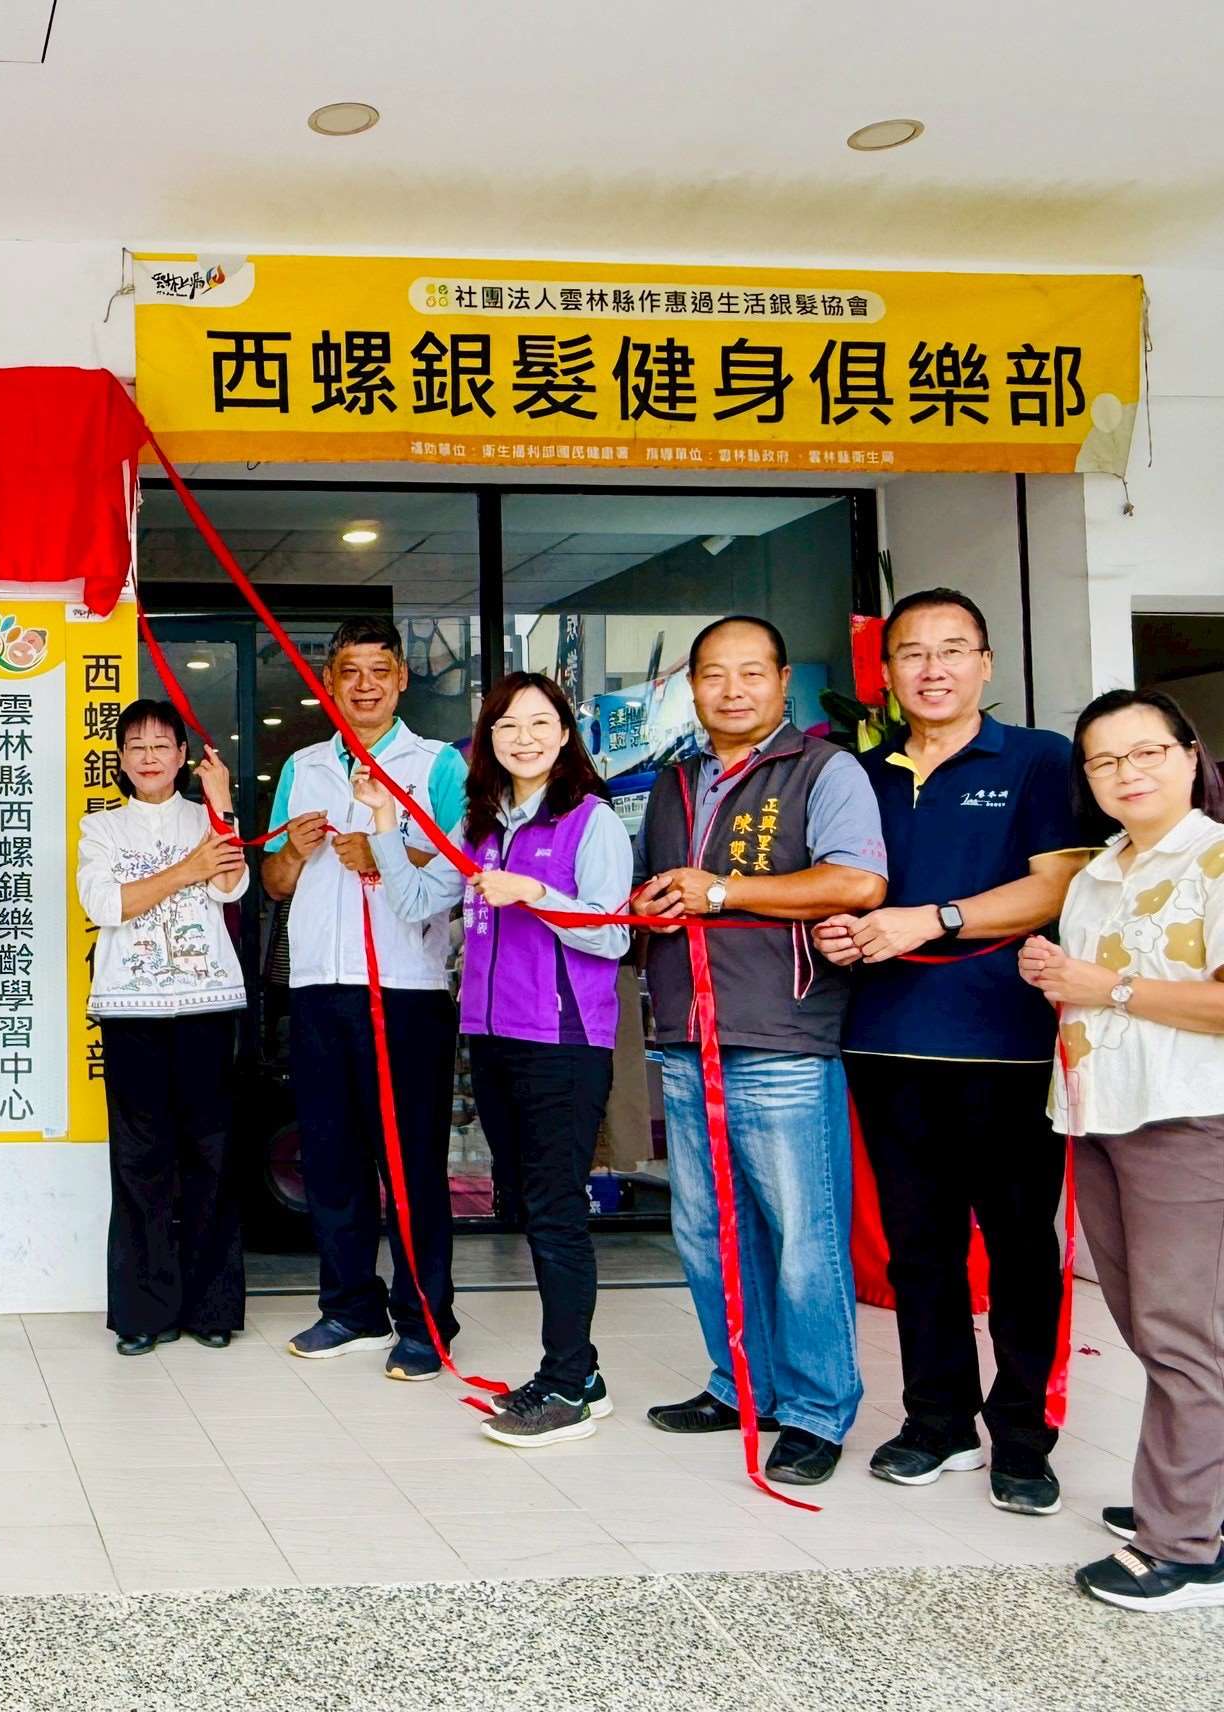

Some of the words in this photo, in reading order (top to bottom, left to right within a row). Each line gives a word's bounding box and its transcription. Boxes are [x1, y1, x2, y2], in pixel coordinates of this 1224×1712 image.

[455, 284, 869, 318] 社團法人雲林縣作惠過生活銀髮協會
[206, 329, 1086, 428] 西螺銀髮健身俱樂部
[753, 798, 779, 871] 正興里長
